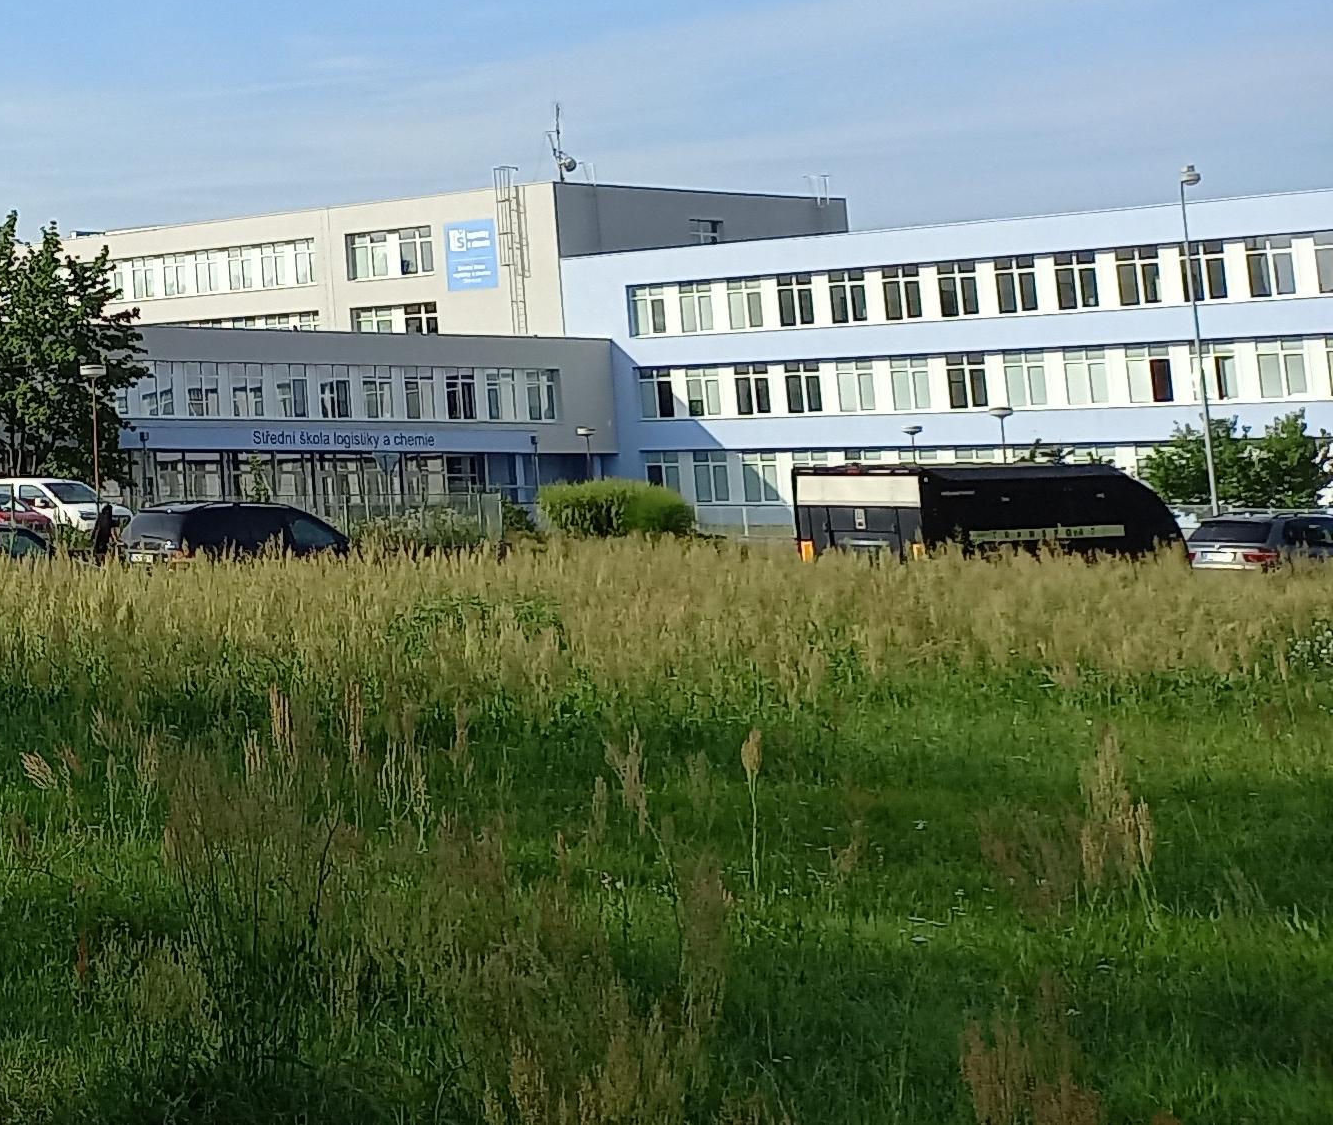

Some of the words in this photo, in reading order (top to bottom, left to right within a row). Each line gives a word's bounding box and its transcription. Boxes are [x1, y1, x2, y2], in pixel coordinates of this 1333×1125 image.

[252, 430, 296, 446] Střední
[299, 431, 330, 446] škola
[333, 431, 380, 449] logistiky
[383, 434, 391, 446] a
[393, 432, 435, 447] chemie
